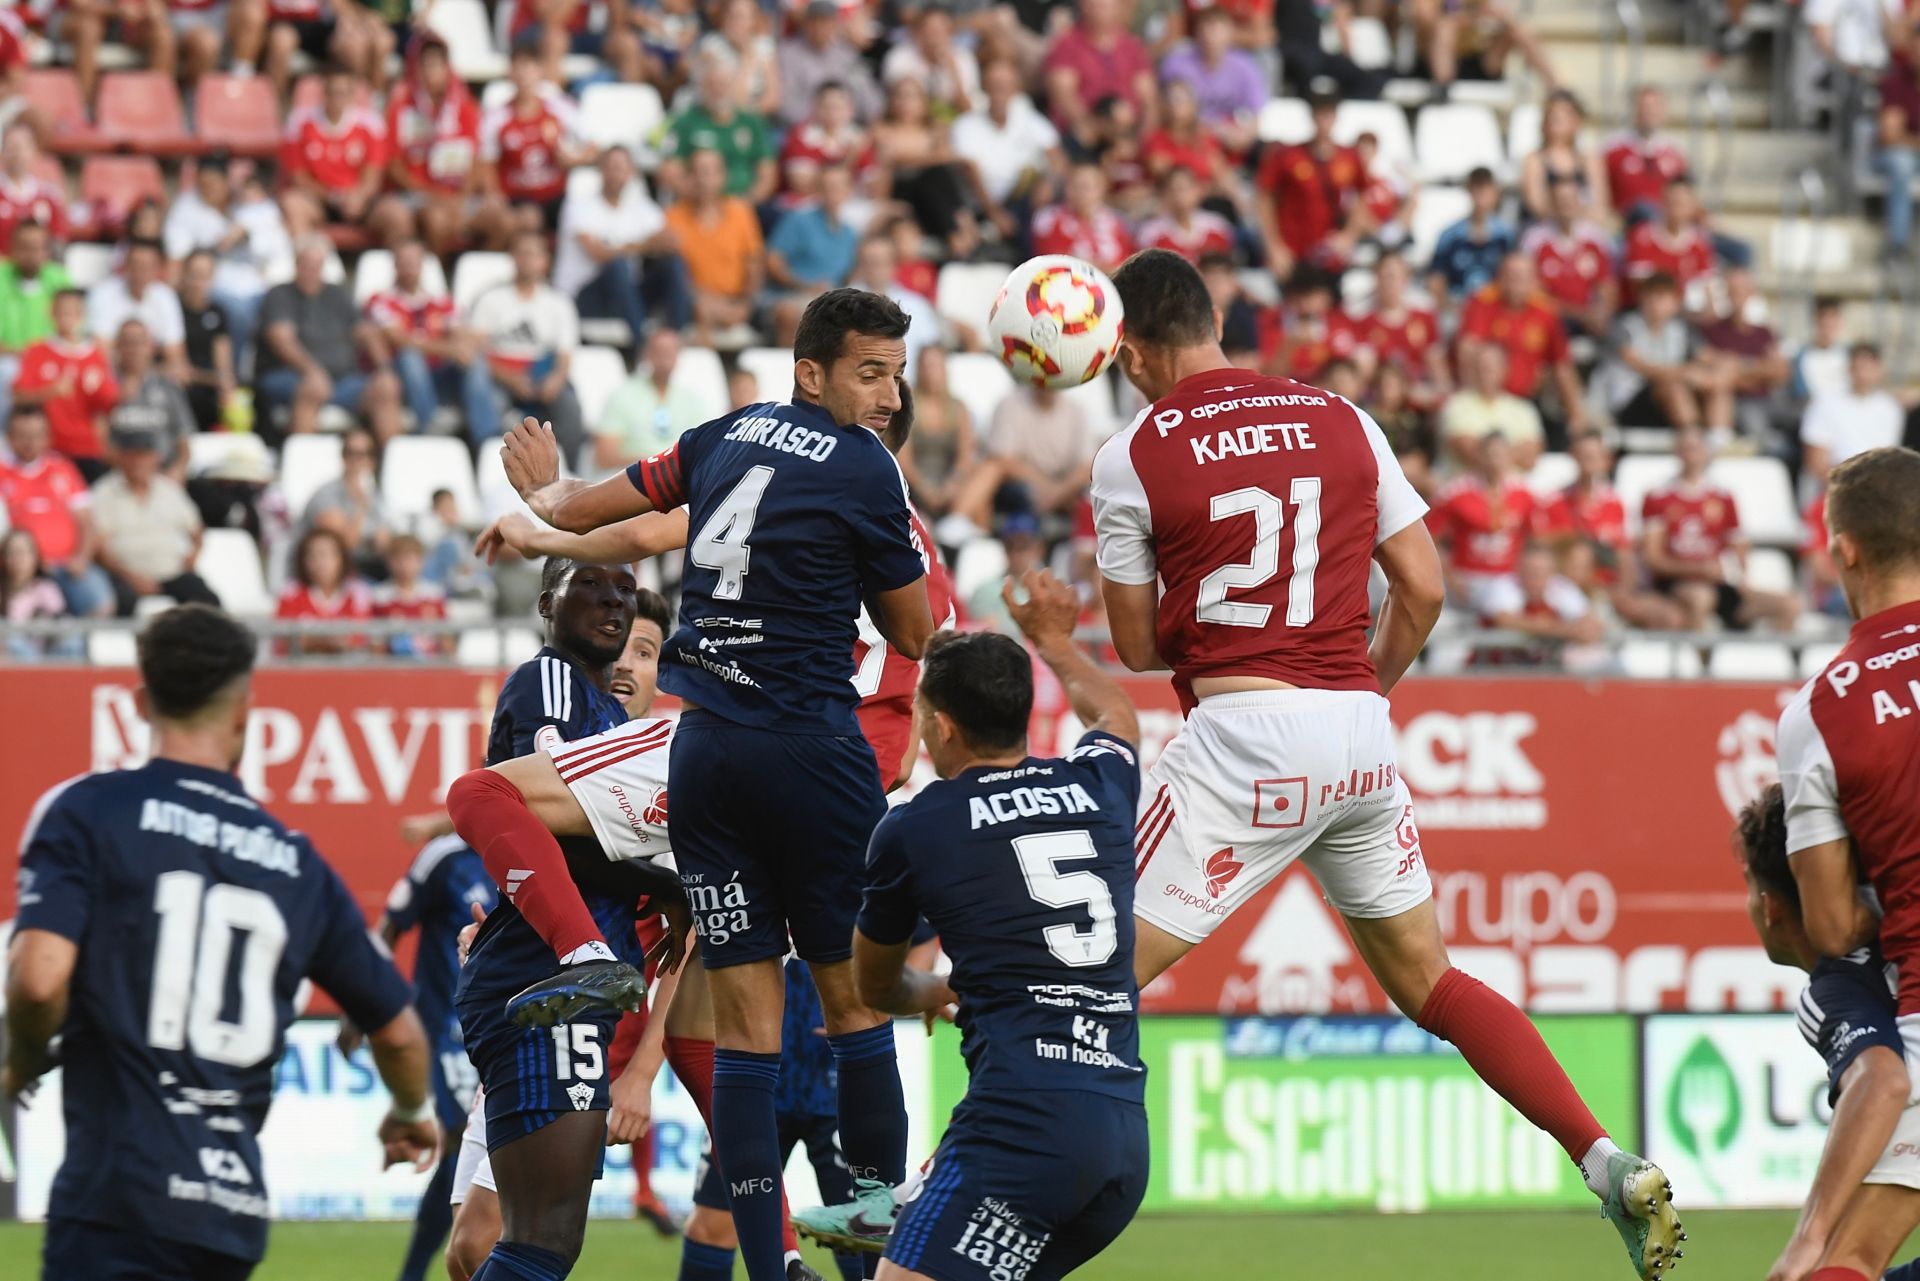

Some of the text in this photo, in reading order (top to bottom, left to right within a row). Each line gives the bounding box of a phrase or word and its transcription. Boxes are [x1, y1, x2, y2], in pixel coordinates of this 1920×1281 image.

[1190, 394, 1328, 418] aparcamurcia
[1189, 422, 1317, 465] KADETE
[690, 465, 776, 600] 4
[1196, 476, 1322, 629] 21
[1864, 643, 1920, 670] apar
[242, 706, 480, 804] PAVI
[608, 785, 651, 843] grupolucas
[969, 783, 1100, 830] ACOSTA
[1010, 829, 1118, 967] 5
[1435, 870, 1617, 948] rupo
[692, 909, 752, 945] aga
[147, 869, 290, 1069] 10
[551, 1024, 604, 1080] 15
[1035, 1037, 1067, 1060] hm
[731, 1177, 774, 1198] MFC
